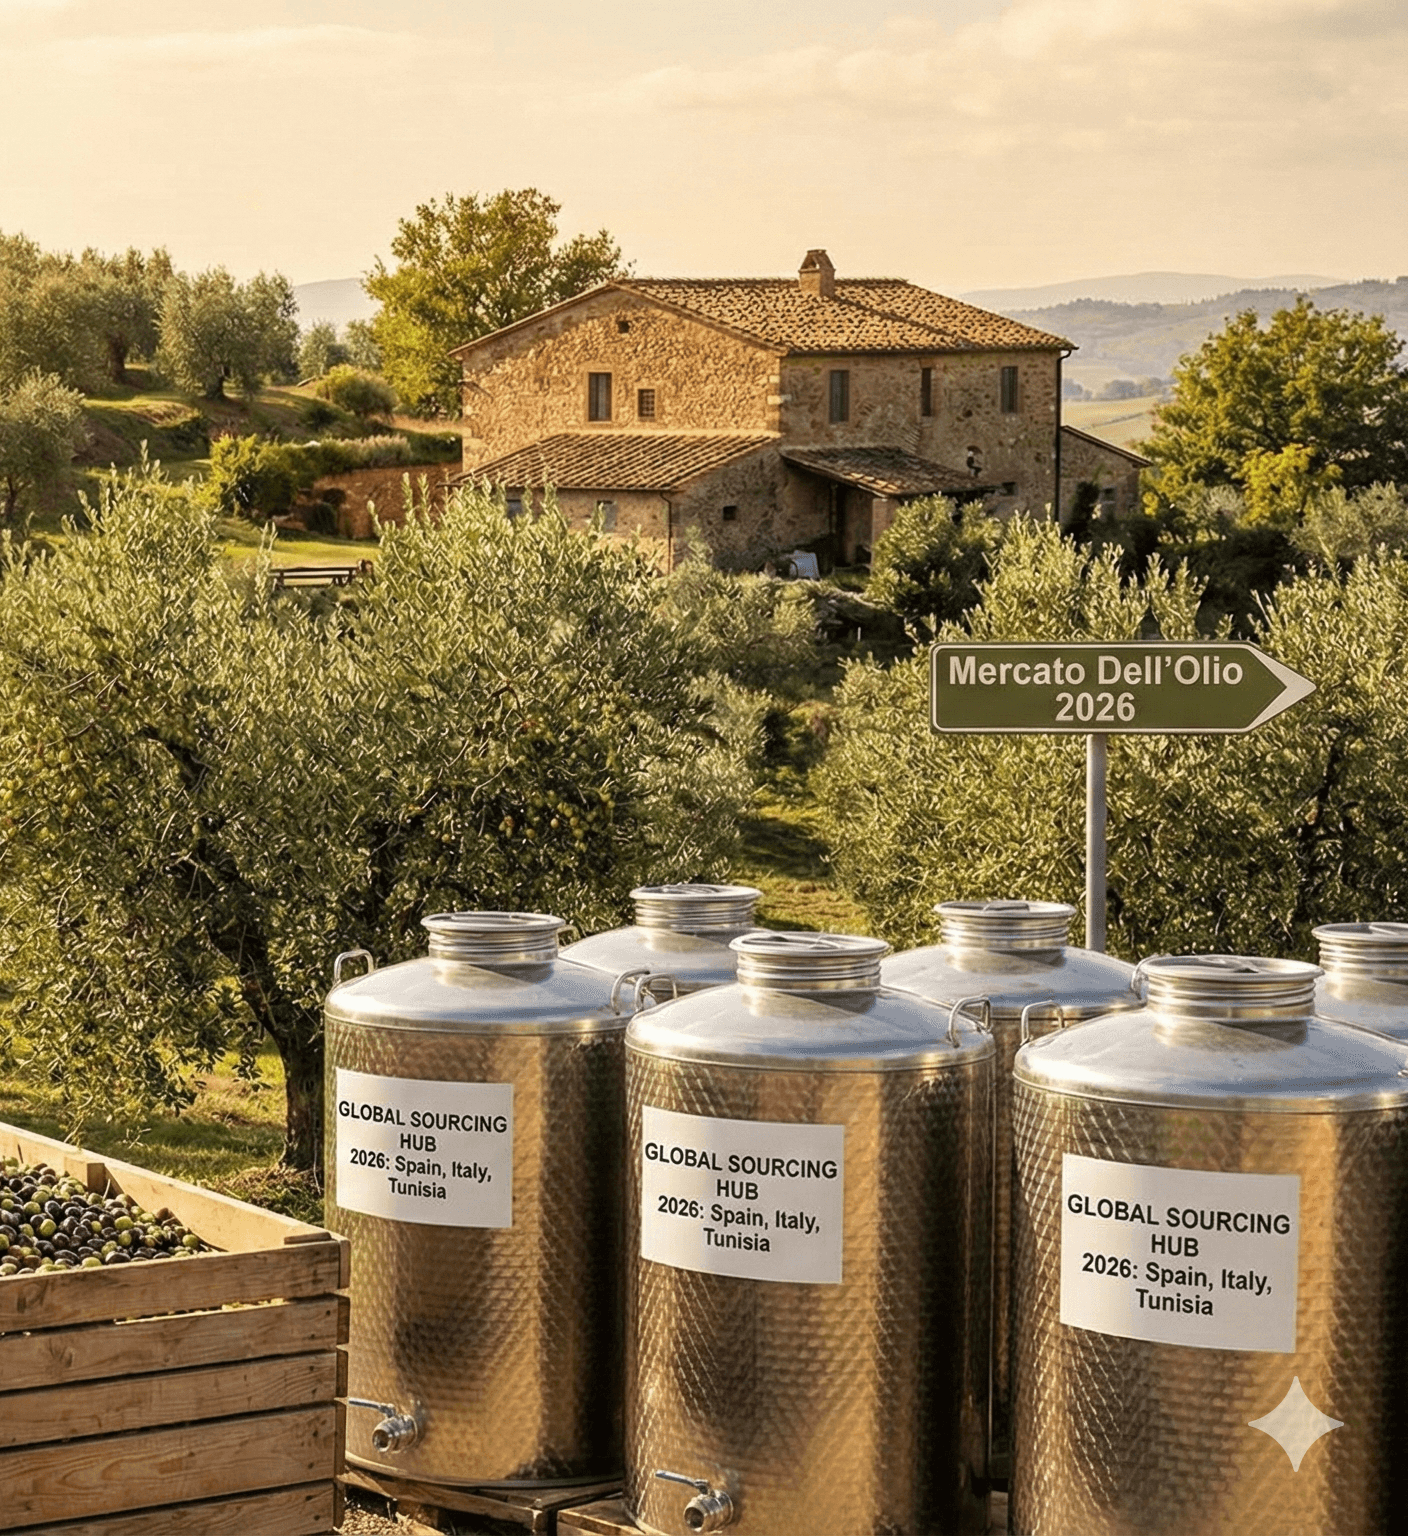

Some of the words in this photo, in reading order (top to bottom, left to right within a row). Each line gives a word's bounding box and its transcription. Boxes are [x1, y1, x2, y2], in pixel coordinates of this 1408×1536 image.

[949, 655, 1085, 685] Mercato
[1055, 692, 1136, 722] 2026
[339, 1101, 405, 1126] GLOBAL
[410, 1111, 507, 1133] SOURCING
[400, 1133, 437, 1152] HUB
[350, 1148, 390, 1170] 2026:
[395, 1155, 446, 1178] Spain,
[452, 1161, 491, 1183] Italy,
[645, 1142, 723, 1171] GLOBAL
[728, 1154, 838, 1179] SOURCING
[388, 1177, 446, 1199] Tunisia
[716, 1179, 758, 1200] HUB
[658, 1195, 704, 1219] 2026:
[711, 1204, 768, 1230] Spain,
[775, 1210, 820, 1234] Italy,
[1067, 1194, 1159, 1226] GLOBAL
[1166, 1207, 1290, 1235] SOURCING
[703, 1227, 770, 1252] Tunisia
[1151, 1234, 1199, 1257] HUB
[1082, 1253, 1138, 1280] 2026:
[1145, 1262, 1213, 1292] Spain,
[1222, 1269, 1272, 1296] Italy,
[1136, 1288, 1213, 1316] Tunisia
